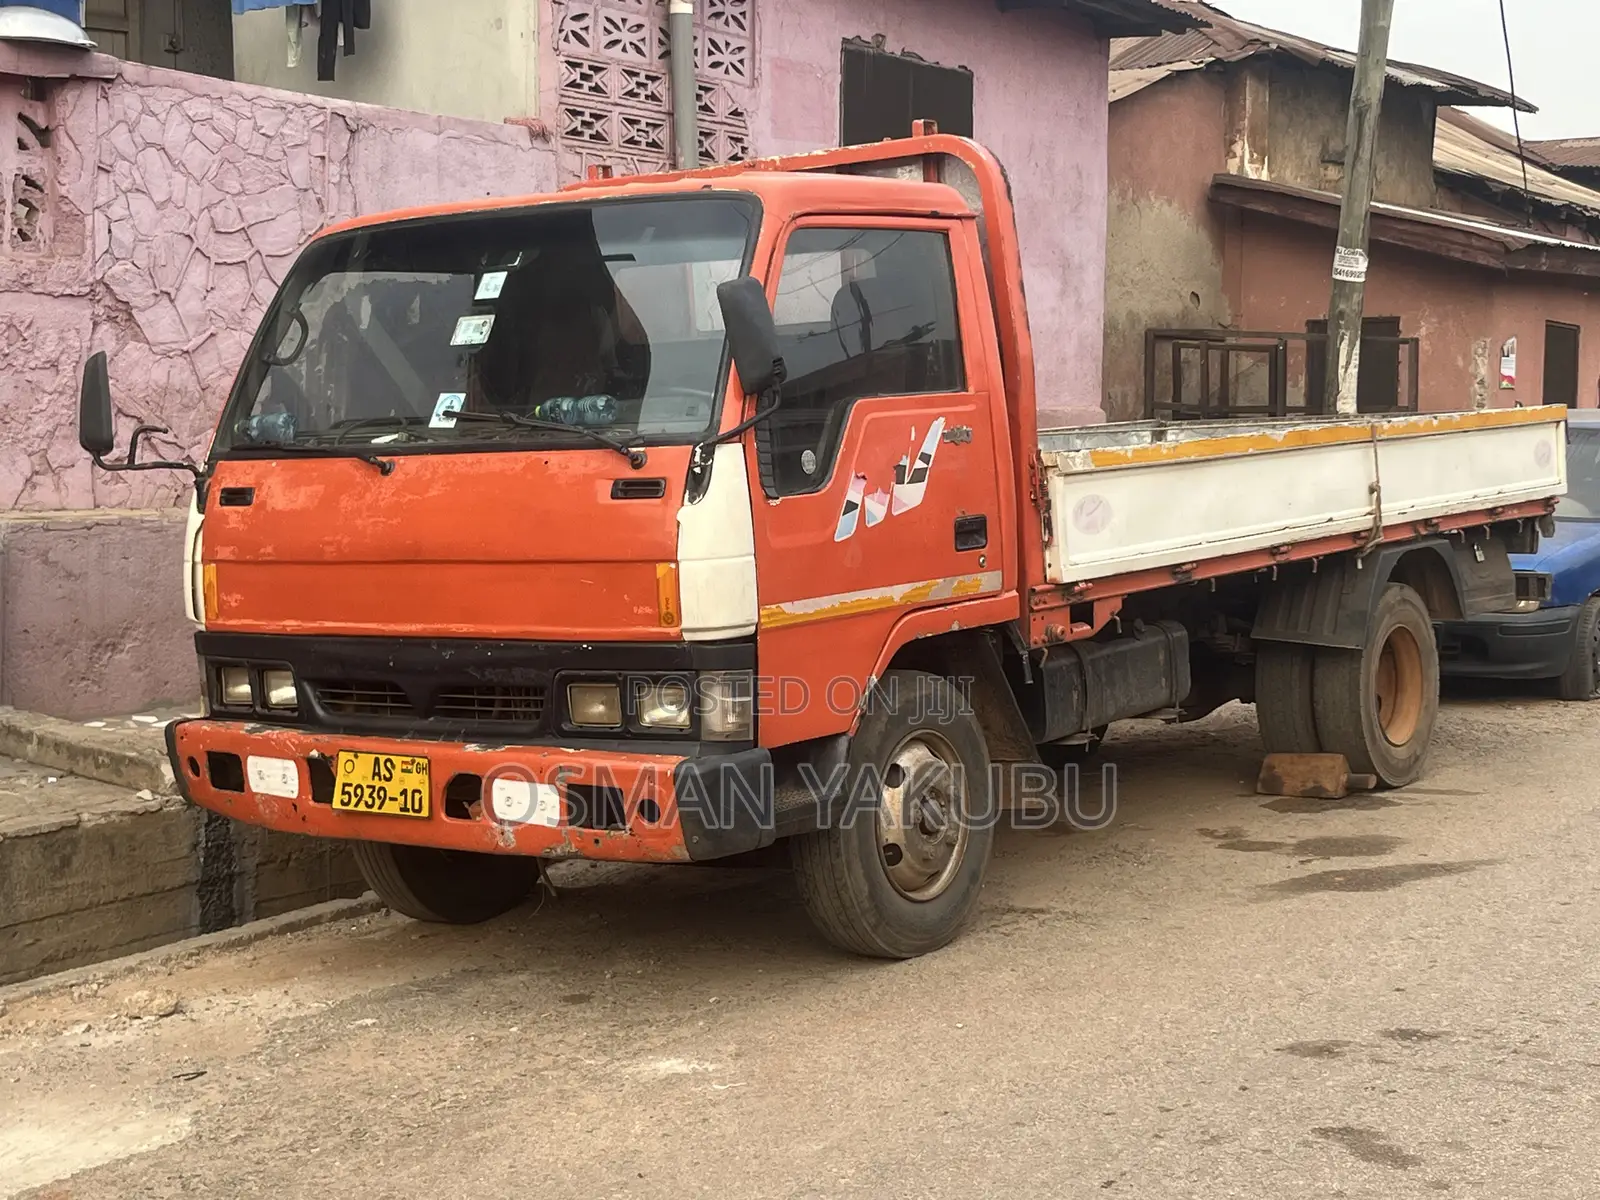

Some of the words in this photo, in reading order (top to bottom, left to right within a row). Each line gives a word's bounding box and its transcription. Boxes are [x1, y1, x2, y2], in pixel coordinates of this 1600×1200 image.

[371, 756, 396, 782] AS
[415, 762, 428, 775] GH
[340, 782, 423, 813] 5939-10
